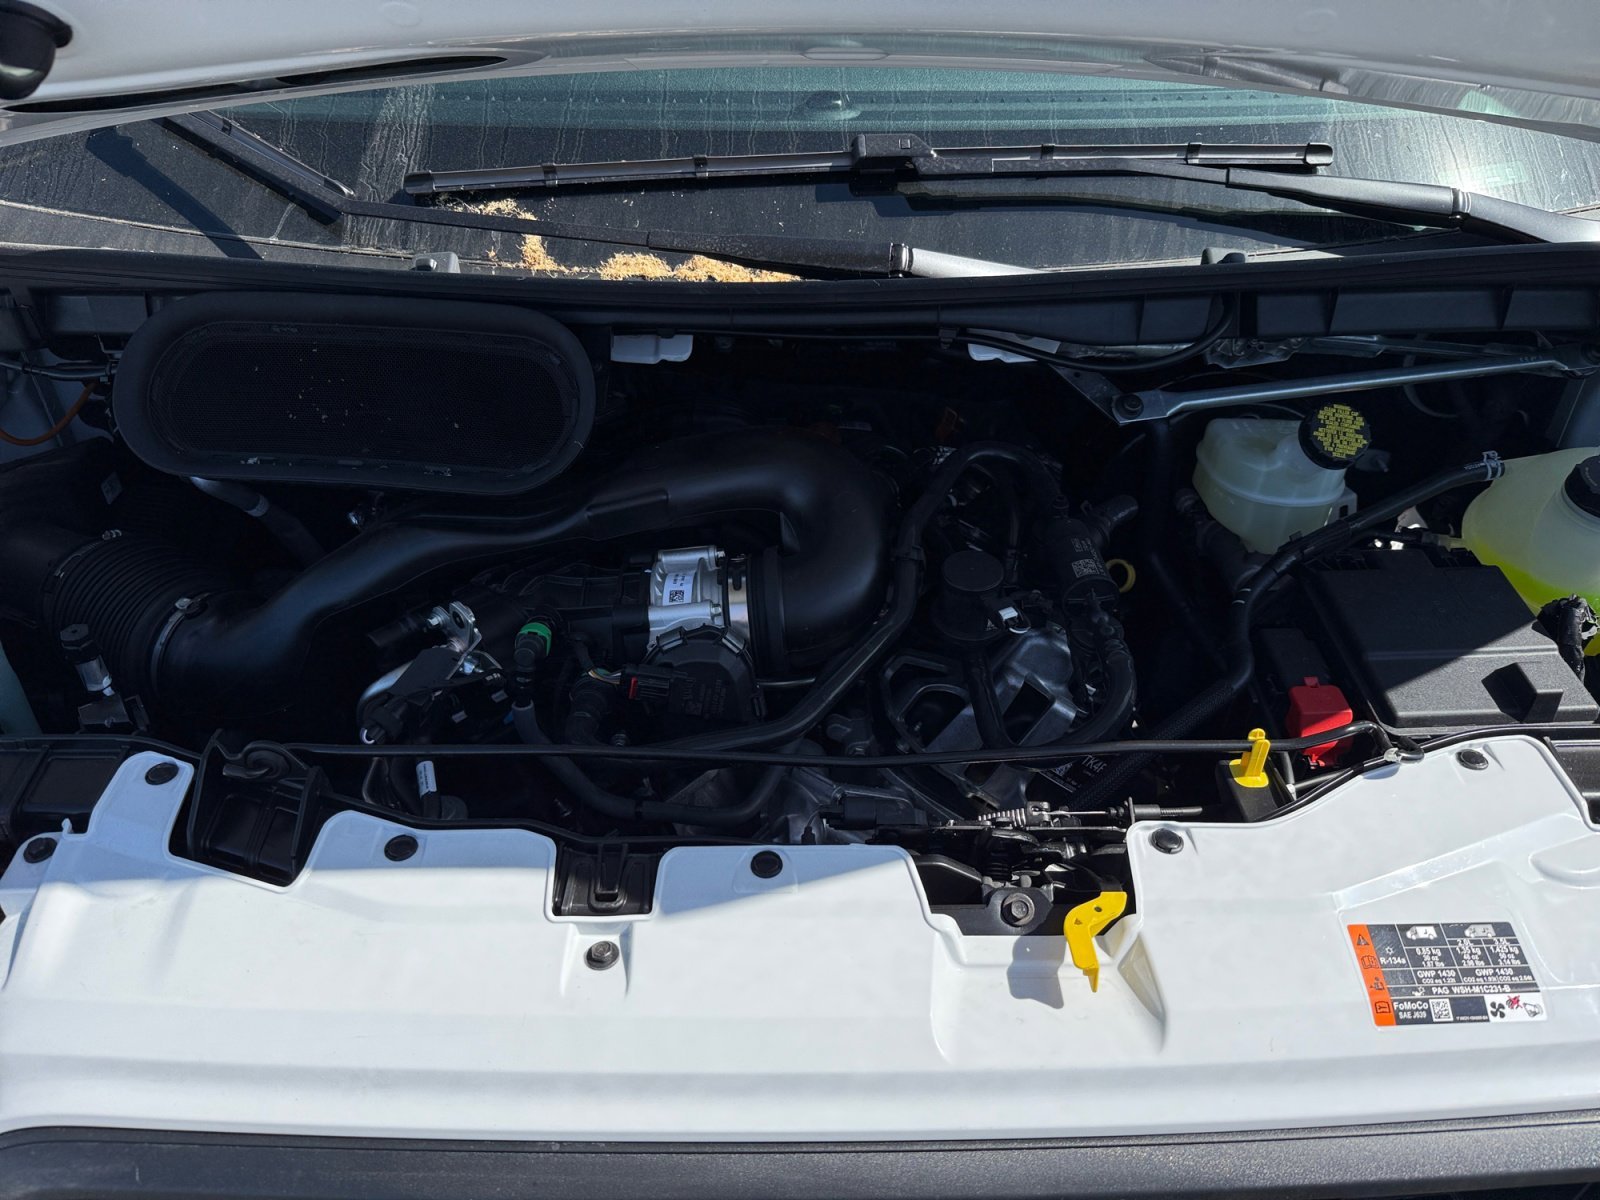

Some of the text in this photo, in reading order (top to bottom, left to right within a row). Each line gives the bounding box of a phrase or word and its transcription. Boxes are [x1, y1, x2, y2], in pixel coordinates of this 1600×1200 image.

[1431, 947, 1442, 956] kg
[1472, 946, 1481, 955] kg
[1509, 945, 1519, 954] kg
[1452, 985, 1511, 994] WSH-M1C231-B
[1393, 1001, 1428, 1010] FoMoCo
